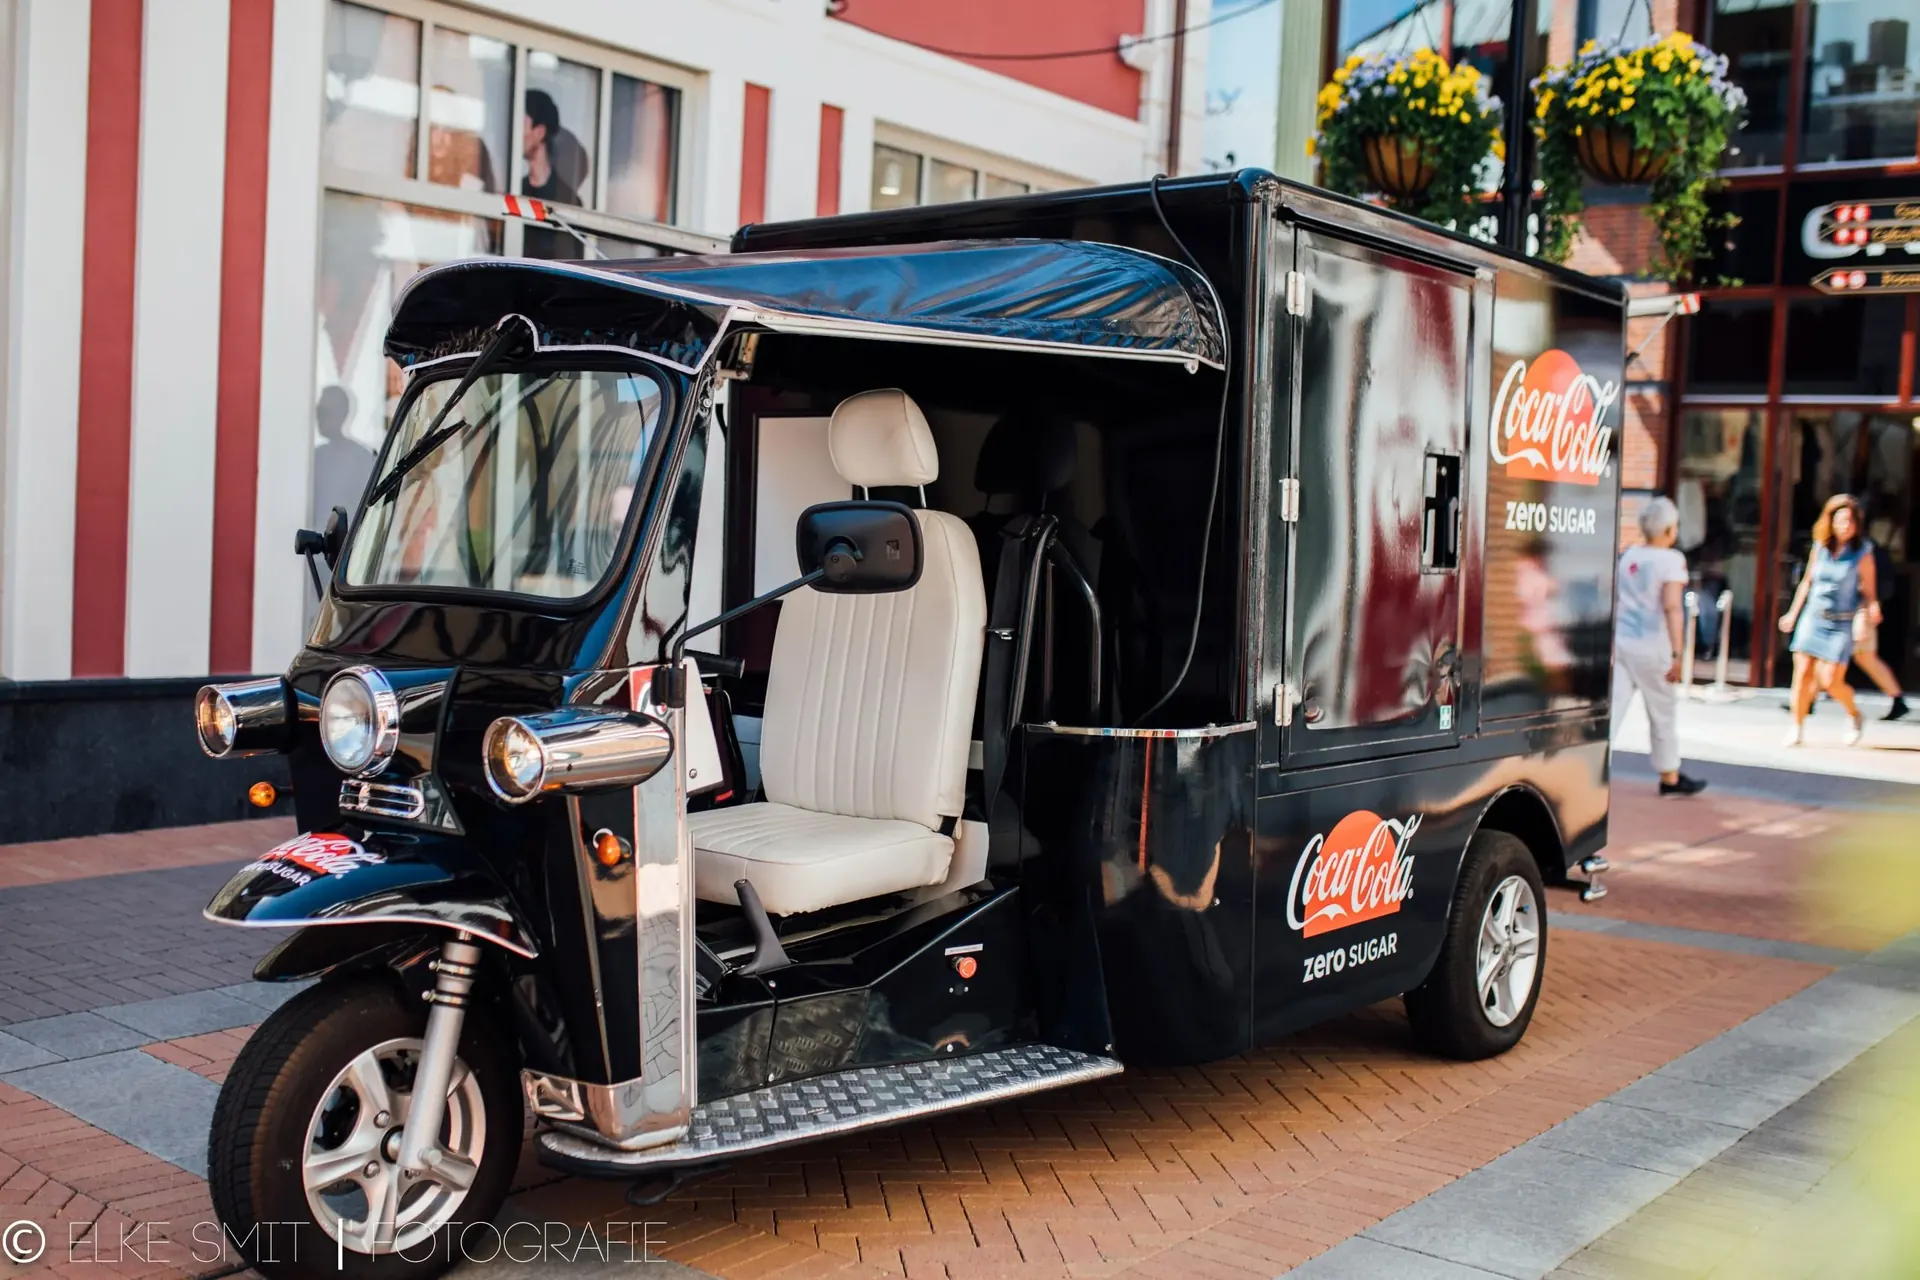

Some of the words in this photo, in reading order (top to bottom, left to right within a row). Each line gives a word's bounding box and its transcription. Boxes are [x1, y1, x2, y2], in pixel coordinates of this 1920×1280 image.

[1505, 501, 1547, 532] zero
[1549, 506, 1596, 534] SUGAR
[267, 861, 312, 887] SUGAR
[1302, 948, 1346, 983] zero
[1348, 932, 1398, 968] SUGAR
